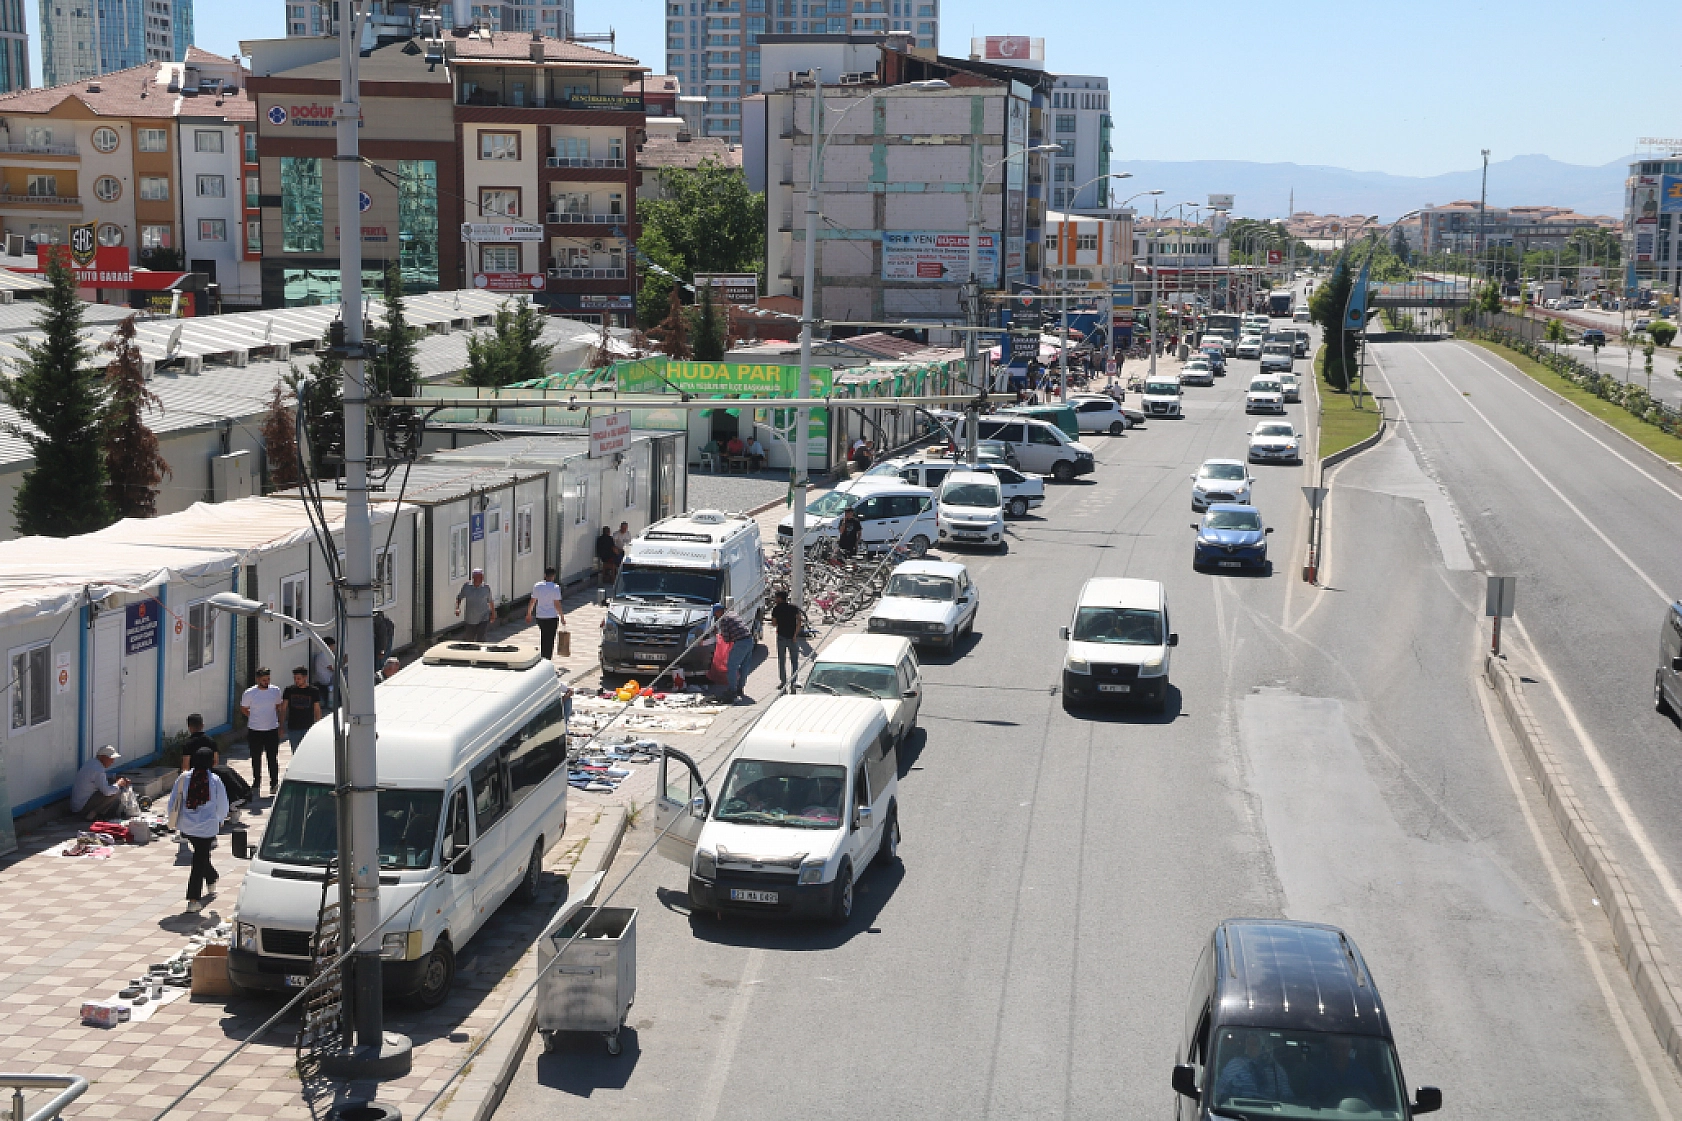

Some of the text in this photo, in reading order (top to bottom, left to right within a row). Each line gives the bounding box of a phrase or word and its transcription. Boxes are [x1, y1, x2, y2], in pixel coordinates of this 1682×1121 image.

[291, 103, 364, 119] DOĞUFL
[75, 270, 134, 282] AUTO GARAGE
[737, 364, 781, 382] PAR
